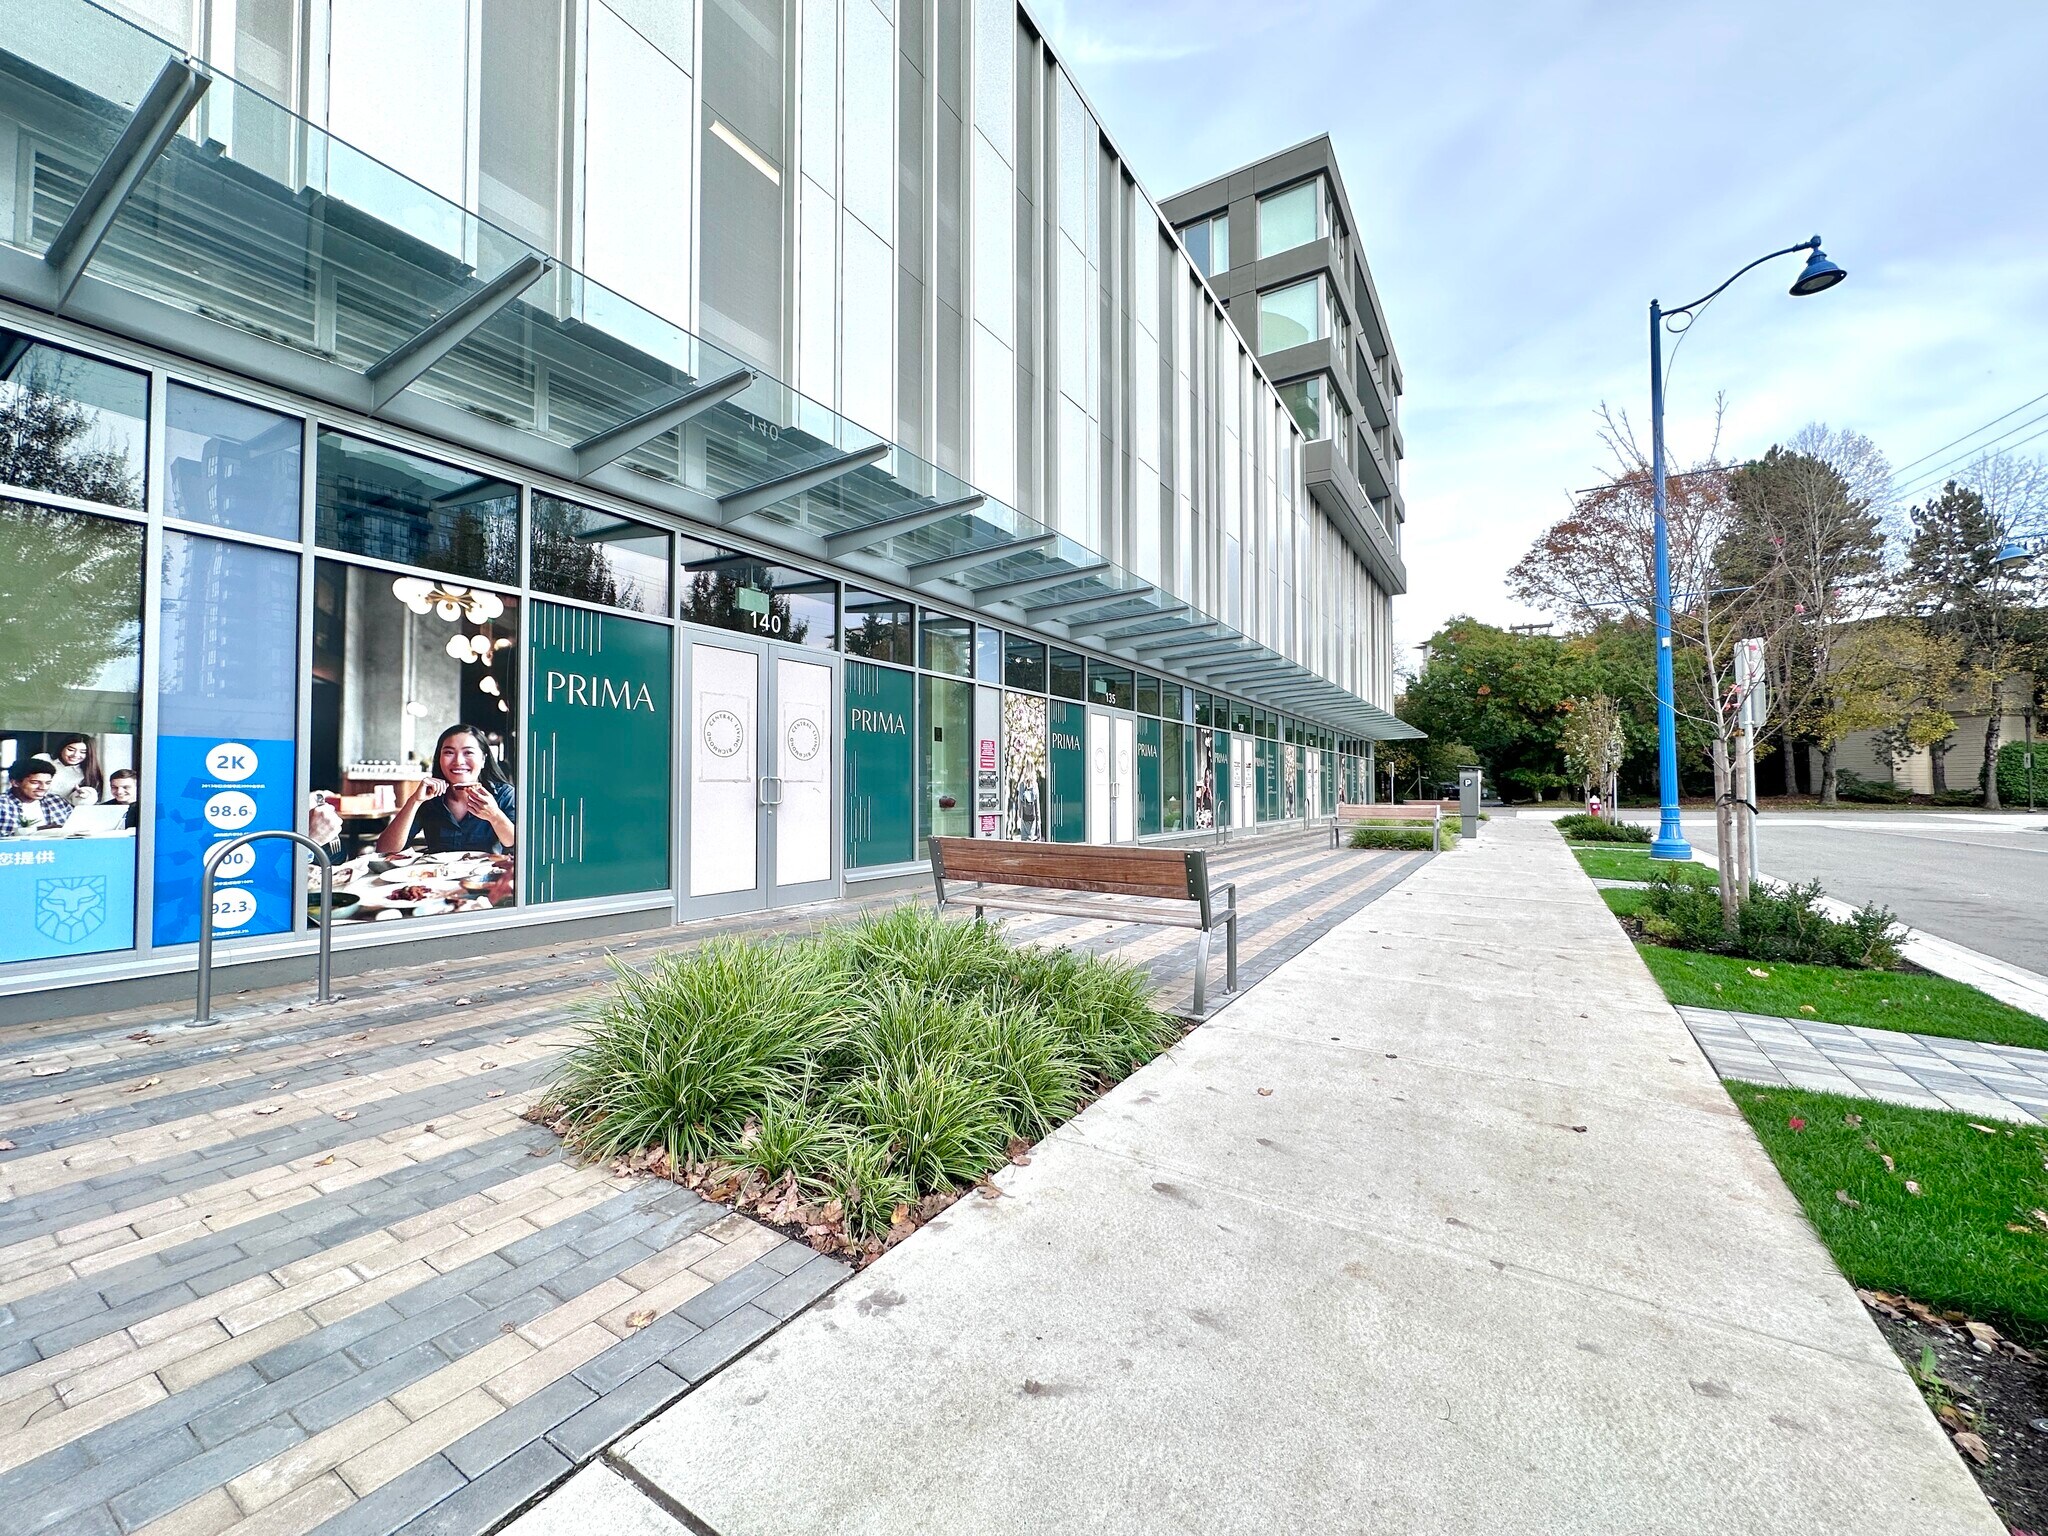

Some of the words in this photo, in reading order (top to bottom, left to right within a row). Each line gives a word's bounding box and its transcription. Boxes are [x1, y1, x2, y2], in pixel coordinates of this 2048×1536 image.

[750, 610, 781, 633] 140
[547, 671, 655, 712] PRIMA
[1105, 692, 1116, 705] 135
[709, 714, 733, 727] CENTRAL
[851, 708, 906, 735] PRIMA
[1052, 732, 1081, 751] PRIMA
[1137, 742, 1158, 758] PRIMA
[217, 755, 245, 769] 2K
[1465, 779, 1472, 787] P
[222, 853, 244, 865] 00
